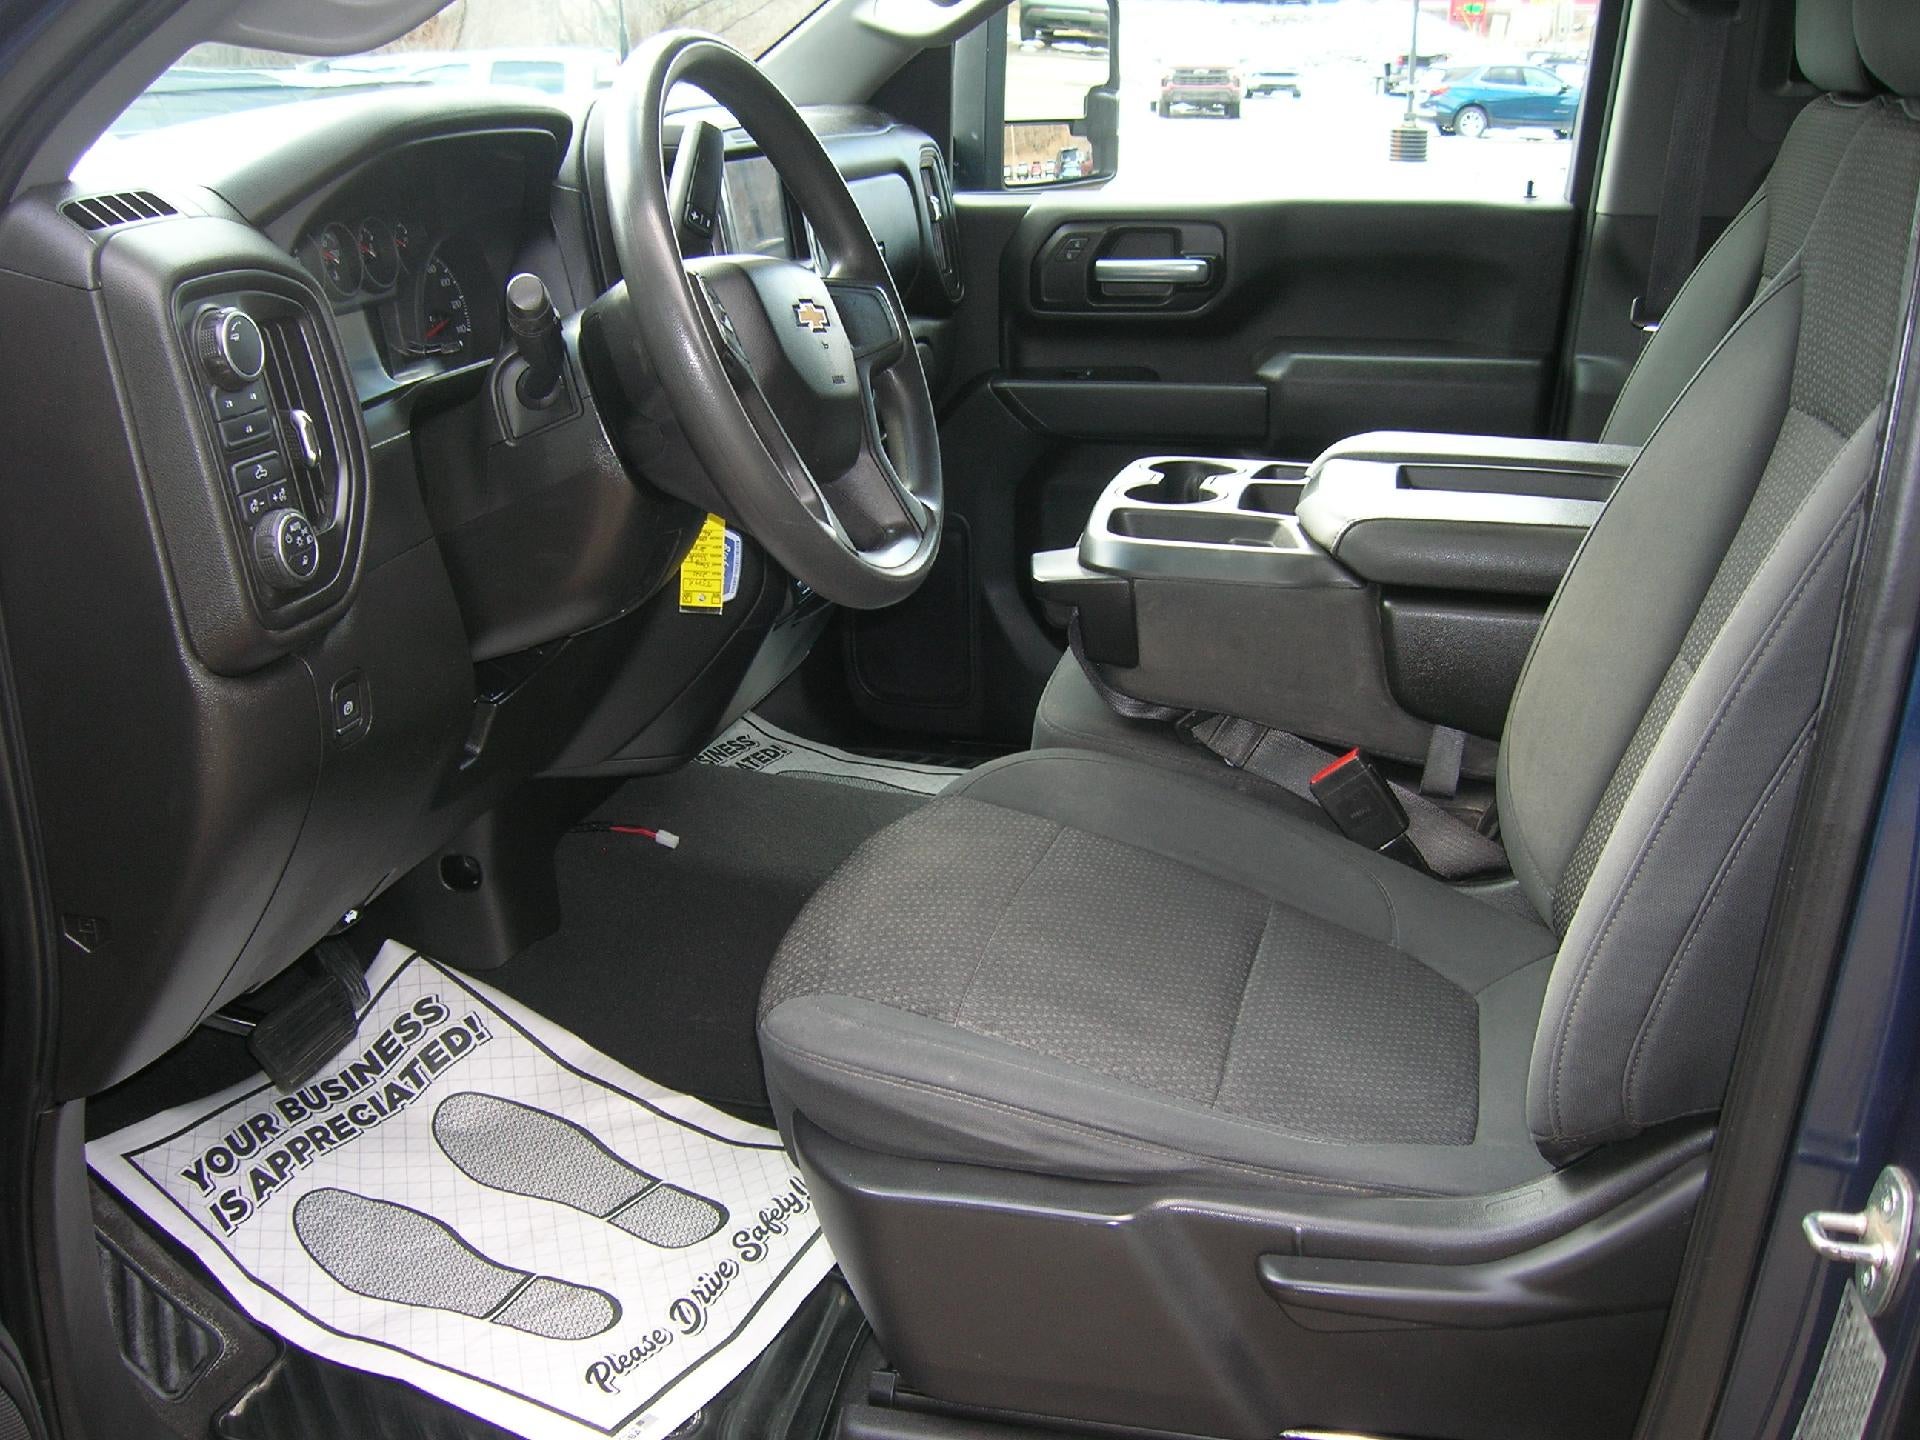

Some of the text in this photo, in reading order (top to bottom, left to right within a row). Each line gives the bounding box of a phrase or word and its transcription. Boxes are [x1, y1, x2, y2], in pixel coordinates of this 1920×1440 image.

[181, 994, 450, 1197] YOUR BUSINESS
[209, 1012, 493, 1236] IS APPRECIATED!
[584, 1327, 673, 1394] Please
[669, 1258, 739, 1336] Drive
